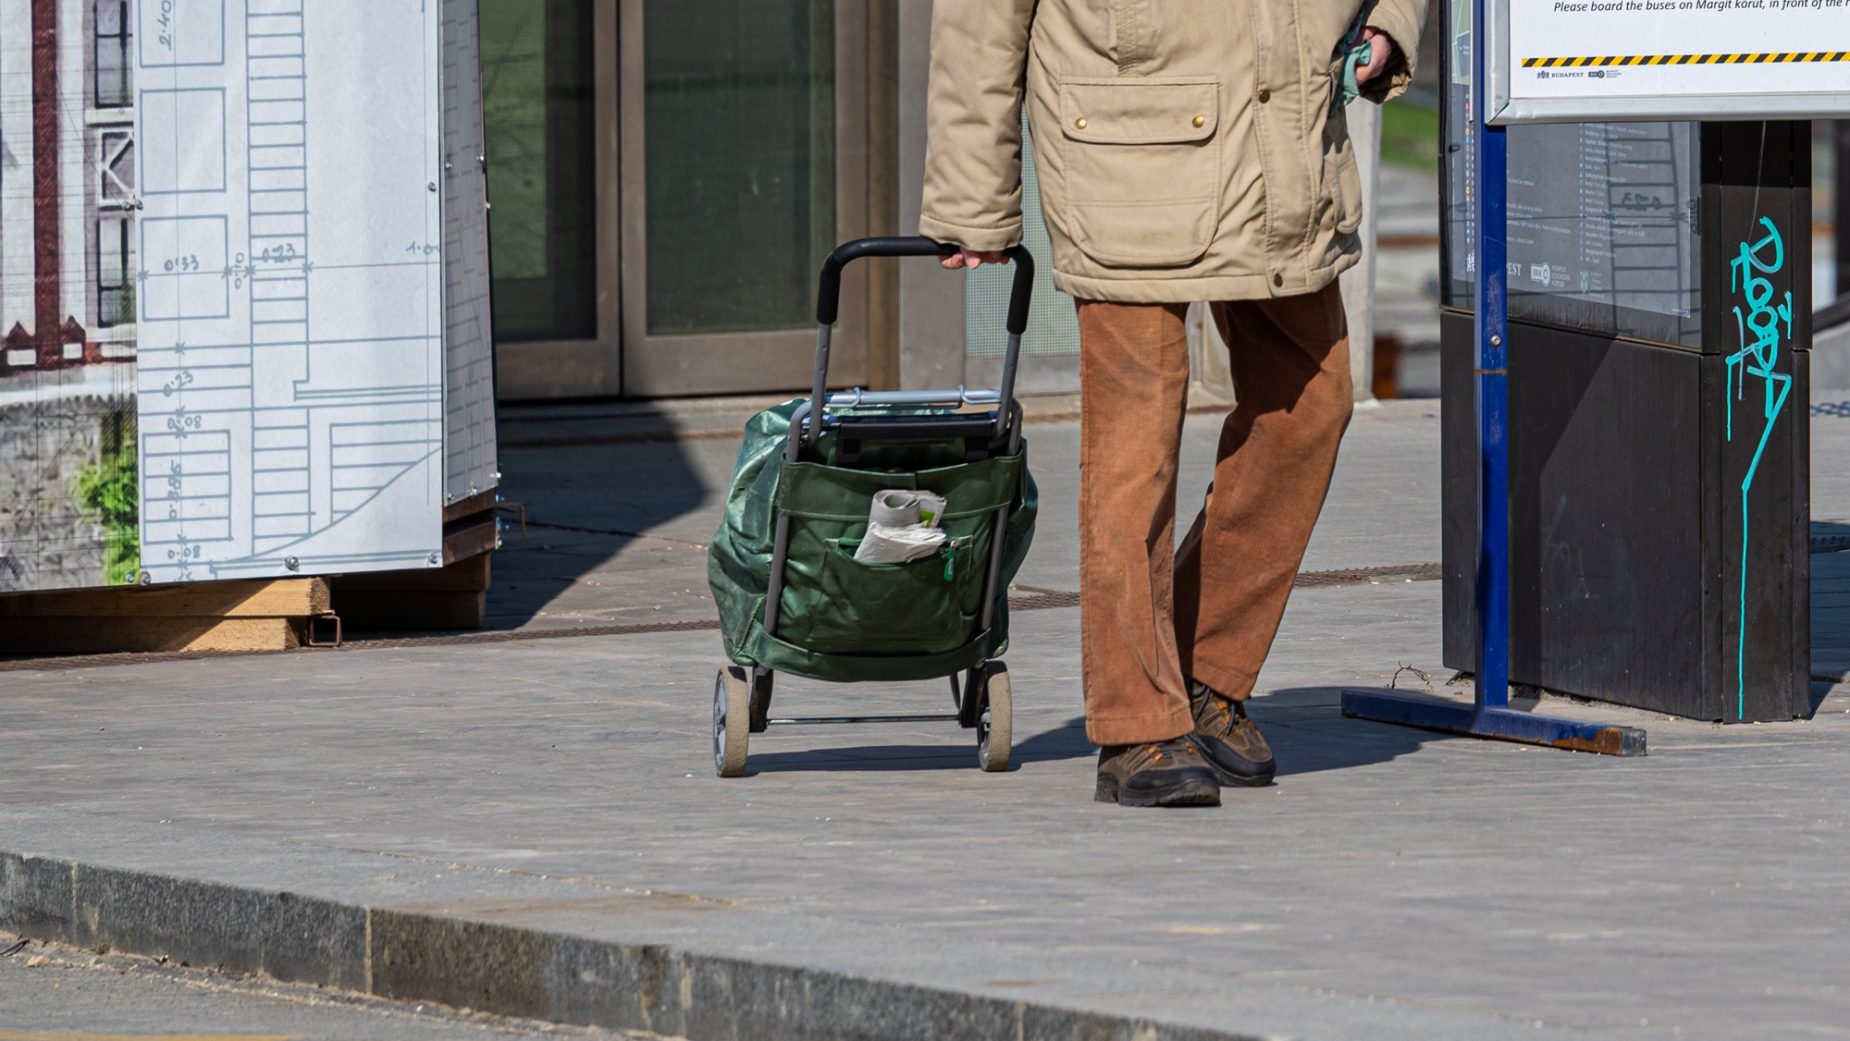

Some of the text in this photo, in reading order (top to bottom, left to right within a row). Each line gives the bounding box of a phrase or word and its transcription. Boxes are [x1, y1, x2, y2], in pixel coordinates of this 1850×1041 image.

[1554, 2, 1588, 12] Please
[1590, 1, 1623, 11] board
[1626, 0, 1643, 11] the
[1646, 0, 1676, 11] buses
[1679, 1, 1693, 10] on
[1696, 0, 1732, 12] Margit
